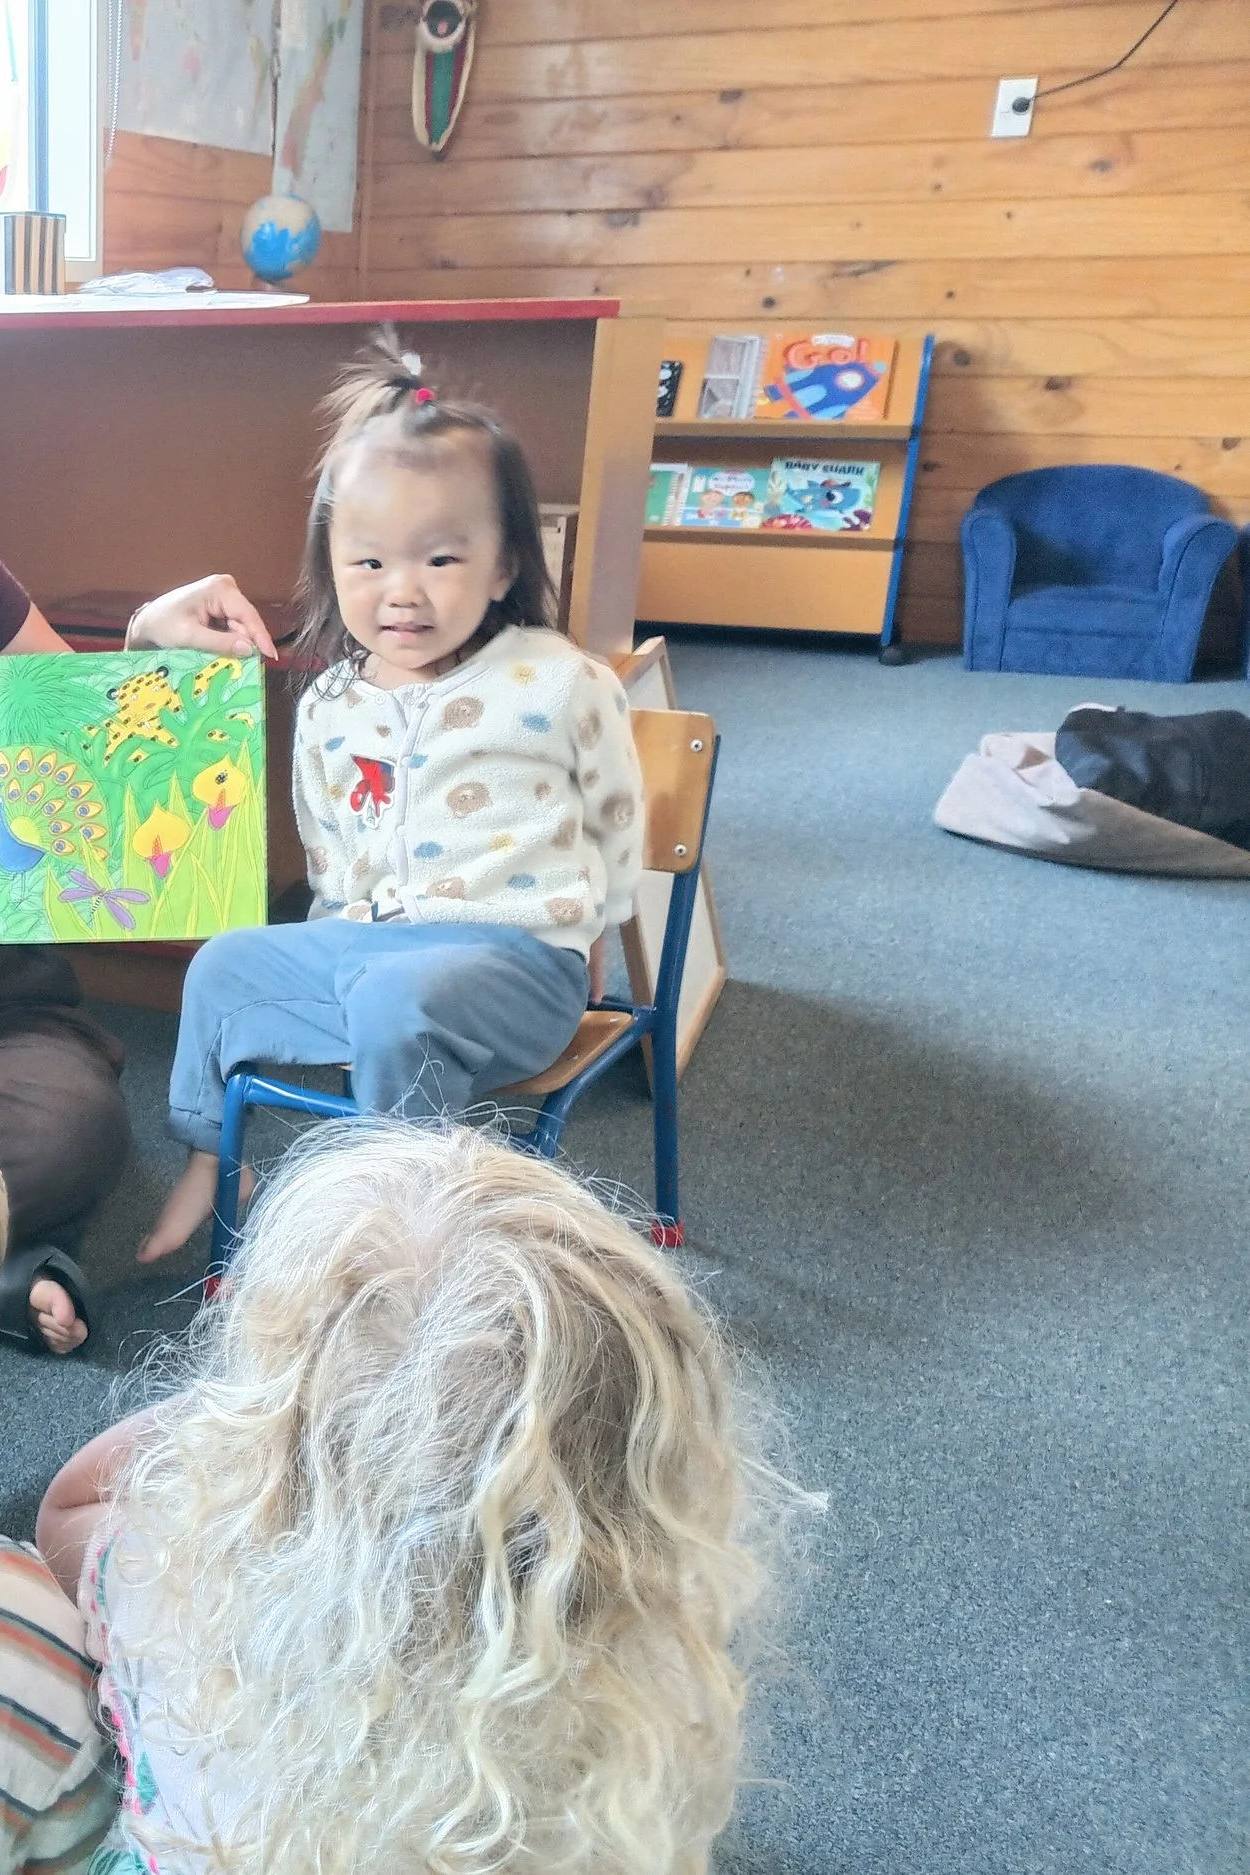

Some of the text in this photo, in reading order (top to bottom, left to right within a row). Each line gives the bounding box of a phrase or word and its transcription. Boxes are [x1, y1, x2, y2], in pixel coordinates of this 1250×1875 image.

[784, 338, 869, 370] Go!
[785, 460, 865, 476] BABY SHARK
